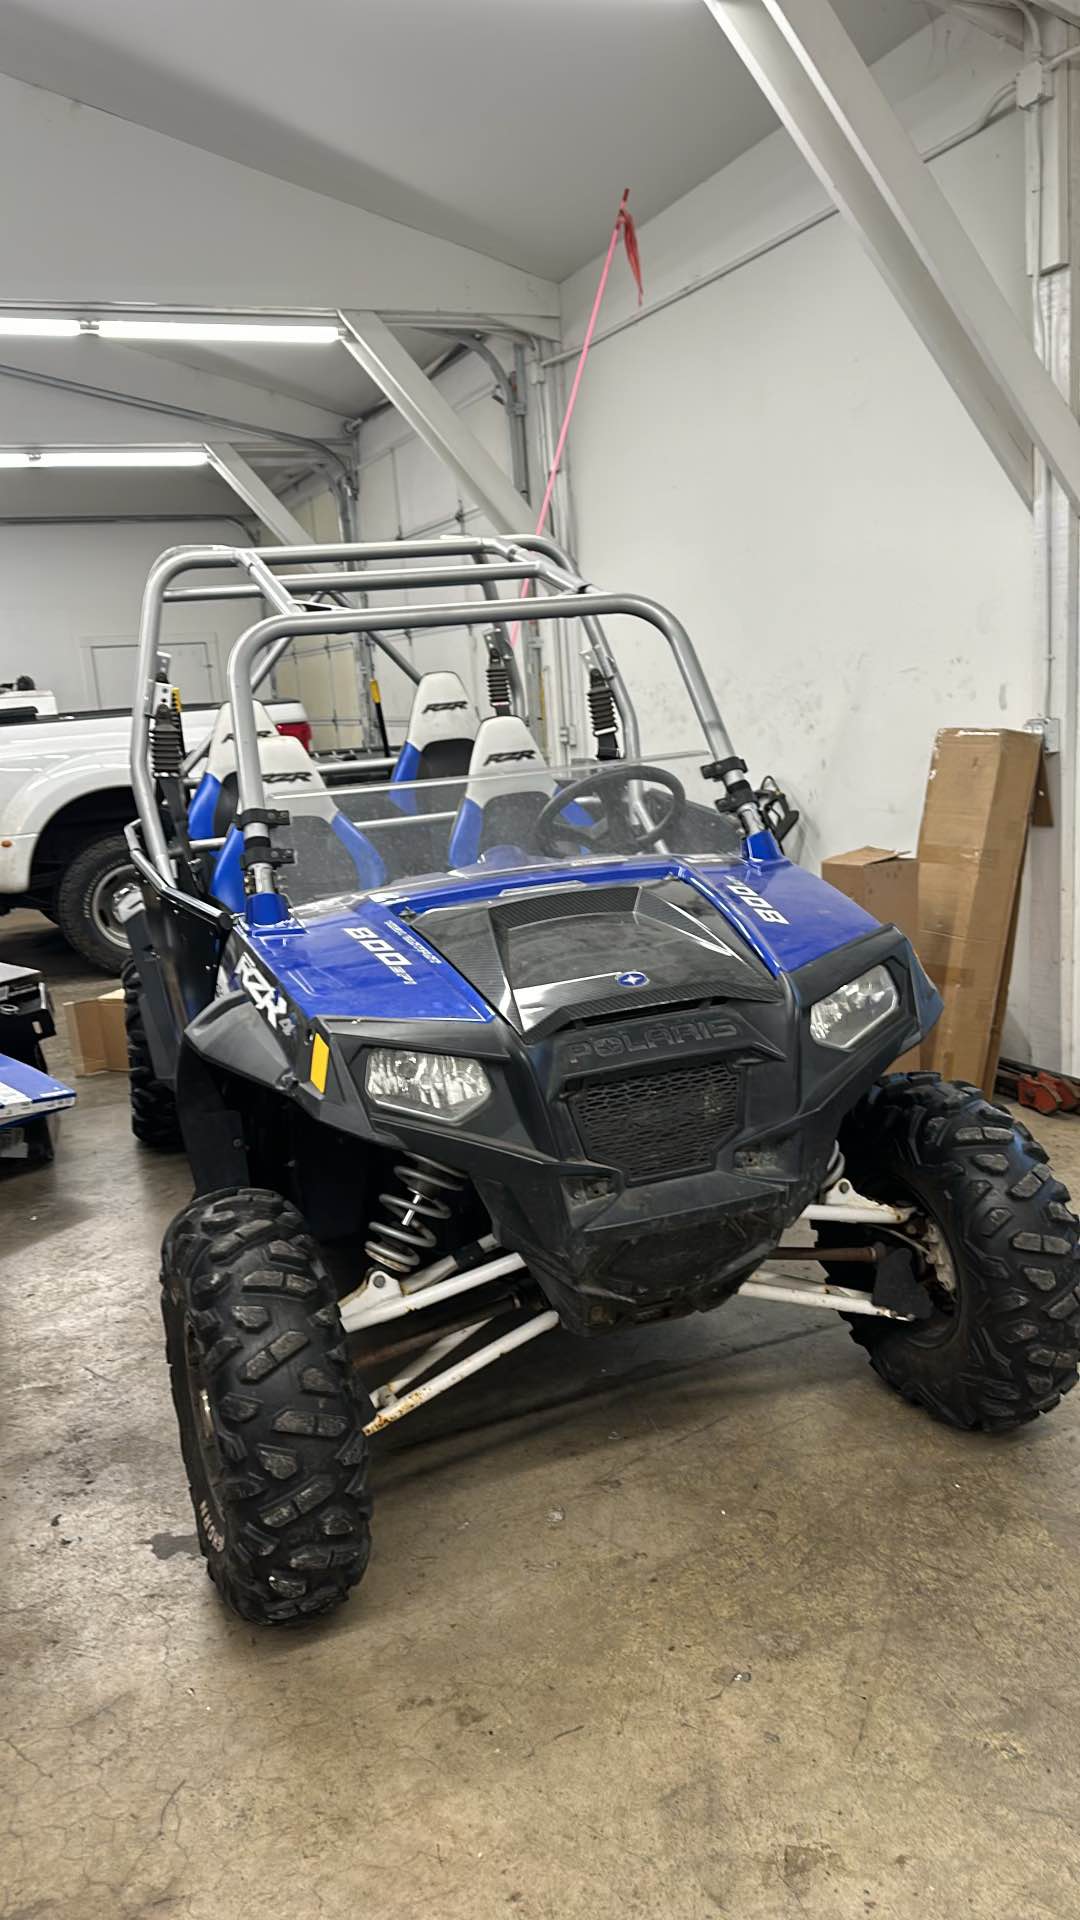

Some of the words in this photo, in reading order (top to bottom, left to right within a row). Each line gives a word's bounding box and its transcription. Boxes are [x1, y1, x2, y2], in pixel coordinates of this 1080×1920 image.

[422, 701, 468, 714] RZR
[483, 750, 536, 767] RZR
[727, 884, 791, 925] 800
[344, 926, 412, 967] 800
[234, 951, 288, 1030] RZR
[566, 1016, 738, 1064] POLARIS
